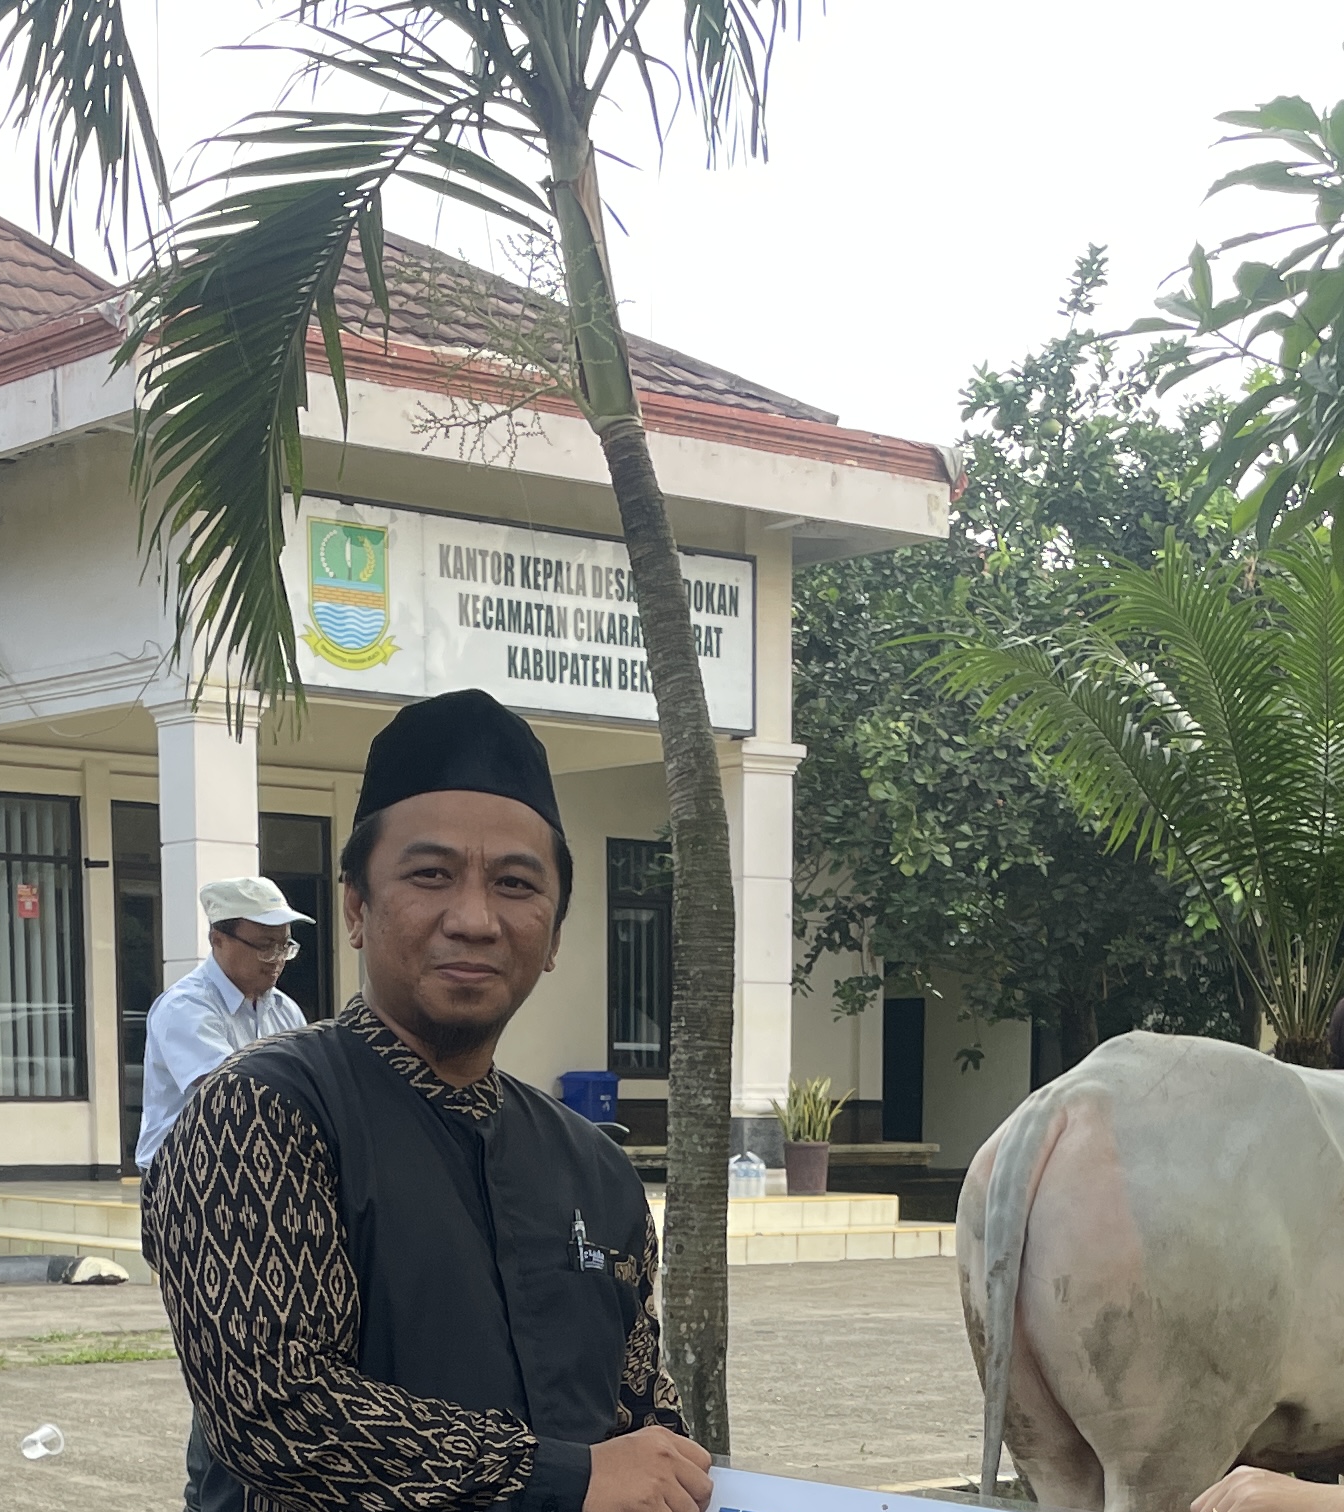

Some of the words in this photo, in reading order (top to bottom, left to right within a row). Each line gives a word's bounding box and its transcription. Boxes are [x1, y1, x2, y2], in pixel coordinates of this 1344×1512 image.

[439, 544, 515, 587] KANTOR
[520, 555, 587, 597] KEPALA
[592, 565, 637, 602] DESA
[682, 579, 739, 617] DOKAN
[459, 593, 568, 639] KECAMATAN
[573, 607, 645, 648] CIKARA
[508, 645, 612, 689] KABUPATEN
[618, 658, 653, 693] BEK
